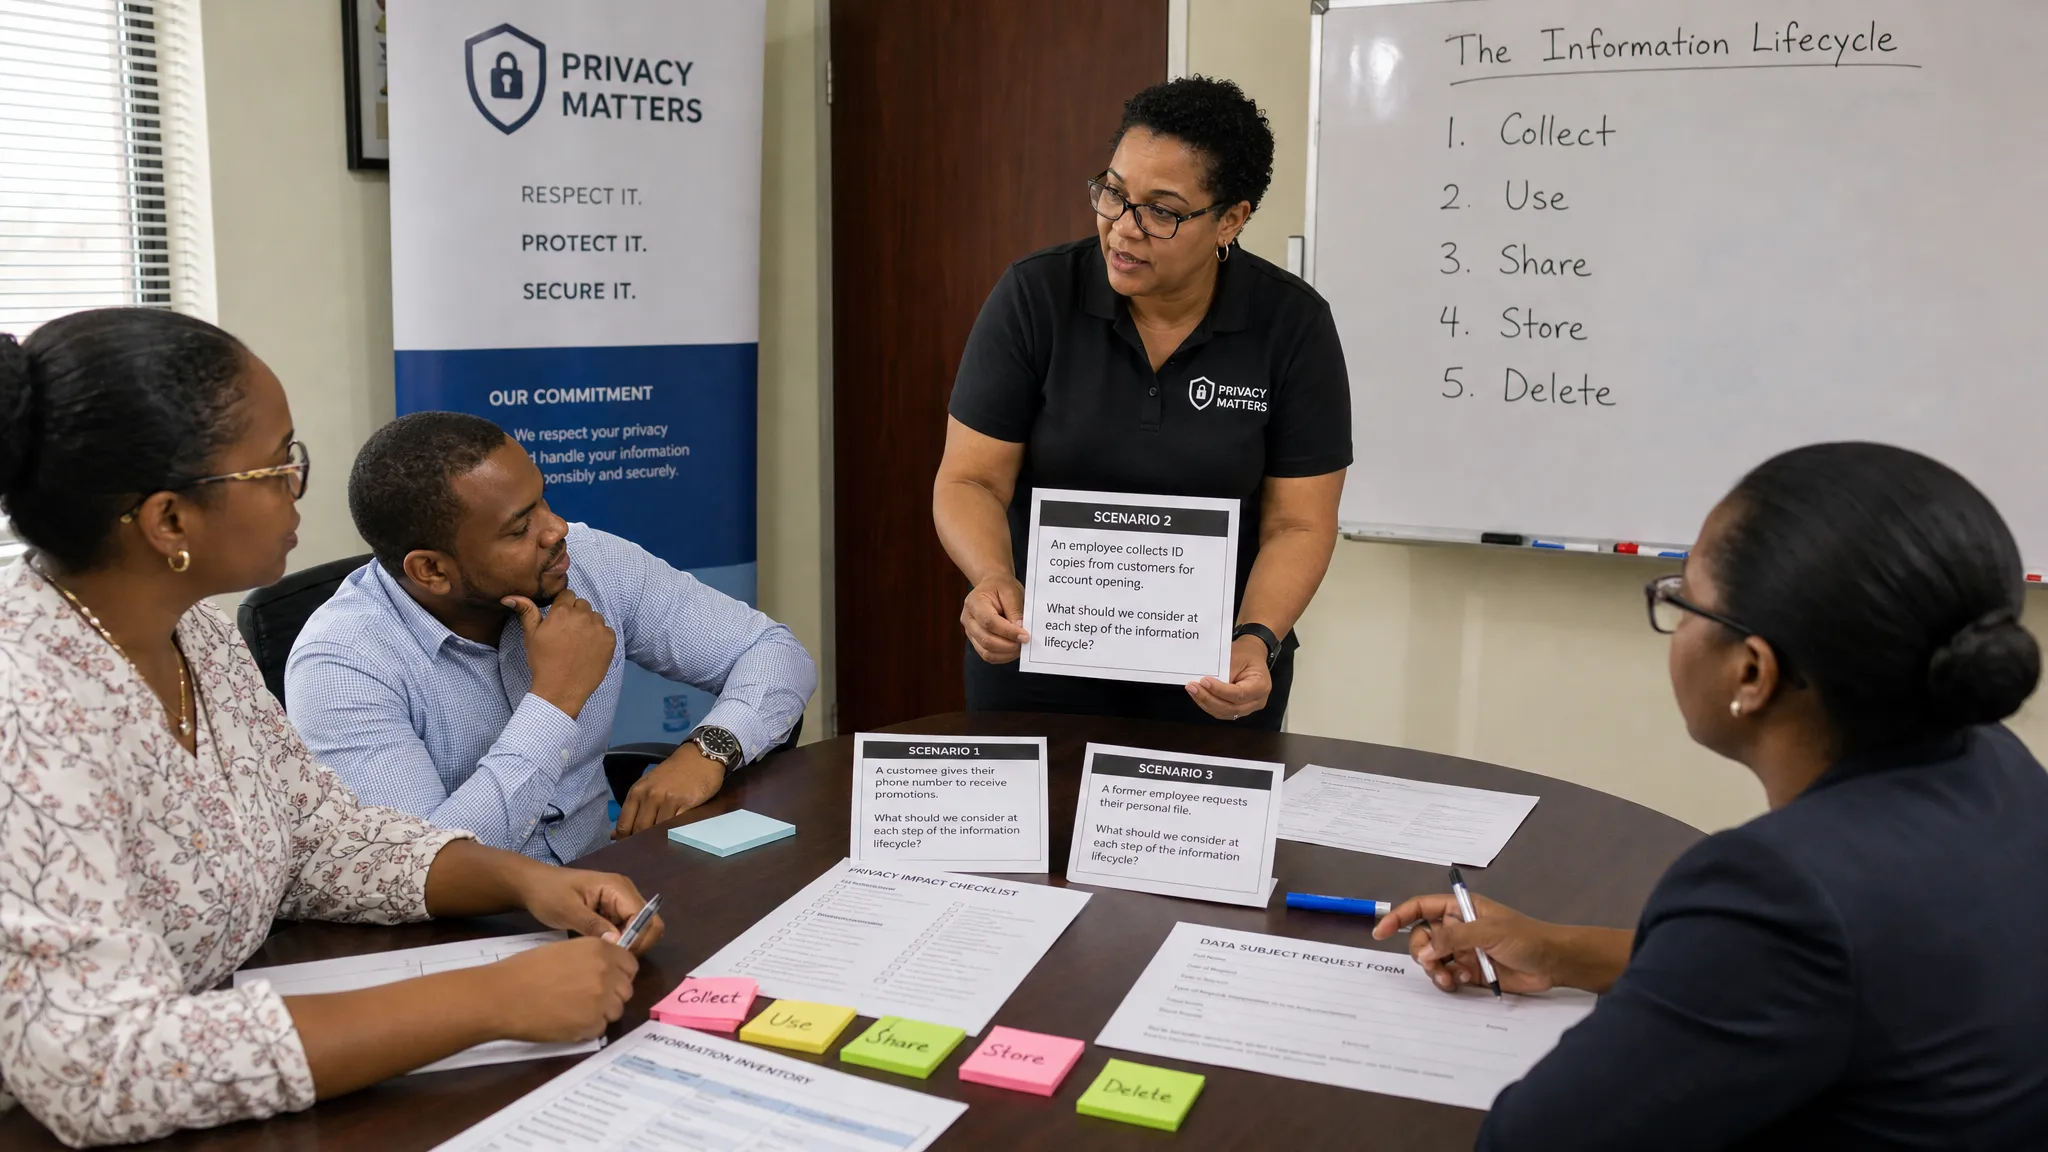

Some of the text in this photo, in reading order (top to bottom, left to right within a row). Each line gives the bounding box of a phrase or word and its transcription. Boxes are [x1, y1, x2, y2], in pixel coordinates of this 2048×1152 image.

[1445, 21, 1898, 68] The Information Lifecycle
[561, 52, 694, 86] PRIVACY
[561, 91, 703, 123] MATTERS
[1447, 112, 1617, 149] 1. Collect
[521, 185, 643, 206] RESPECT IT.
[1440, 180, 1570, 211] 2. Use
[521, 234, 647, 253] PROTECT IT.
[1439, 241, 1593, 278] 3. Share
[523, 282, 636, 300] SECURE IT.
[1439, 306, 1588, 341] 4. Store
[489, 385, 654, 407] OUR COMMITMENT
[1218, 385, 1267, 399] PRIVACY
[1441, 367, 1617, 406] 5. Delete
[1216, 398, 1268, 412] MATTERS
[514, 424, 668, 442] We respect your privacy
[540, 449, 585, 464] handle
[588, 447, 617, 465] your
[619, 444, 690, 460] information
[599, 467, 623, 481] and
[626, 464, 679, 480] securely.
[1094, 511, 1171, 526] SCENARIO 2
[1051, 540, 1184, 557] An employee collects ID
[1050, 557, 1195, 574] copies from customers for
[1049, 574, 1144, 591] account opening.
[1047, 603, 1198, 623] What should we consider at
[1046, 621, 1199, 640] each step of the information
[1044, 637, 1094, 651] lifecycle?
[909, 747, 980, 755] SCENARIO 1
[886, 767, 938, 775] customee
[941, 767, 968, 776] gives
[971, 767, 995, 775] their
[1139, 763, 1213, 779] SCENARIO 3
[875, 779, 909, 788] phone
[875, 791, 938, 800] promotions.
[1102, 784, 1248, 807] A former employee requests
[1100, 798, 1191, 815] their personal file.
[874, 814, 902, 822] What
[904, 814, 940, 822] should
[961, 814, 1005, 822] consider
[874, 826, 1020, 837] each step of the information
[1096, 824, 1239, 847] What should we consider at
[873, 840, 922, 850] lifecycle?
[1093, 838, 1240, 862] each step of the information
[1091, 852, 1139, 865] lifecycle?
[849, 868, 900, 879] PRIVACY
[900, 874, 948, 886] IMPACT
[949, 881, 1020, 897] CHECKLIST
[1200, 938, 1405, 975] DATA SUBJECT REQUEST FORM
[677, 989, 742, 1004] Collect
[769, 1012, 813, 1031] Use
[865, 1019, 929, 1053] Share
[644, 1032, 736, 1063] INFORMATION
[736, 1057, 815, 1085] INVENTORY
[982, 1043, 1045, 1065] Store
[1102, 1078, 1173, 1103] Delete
